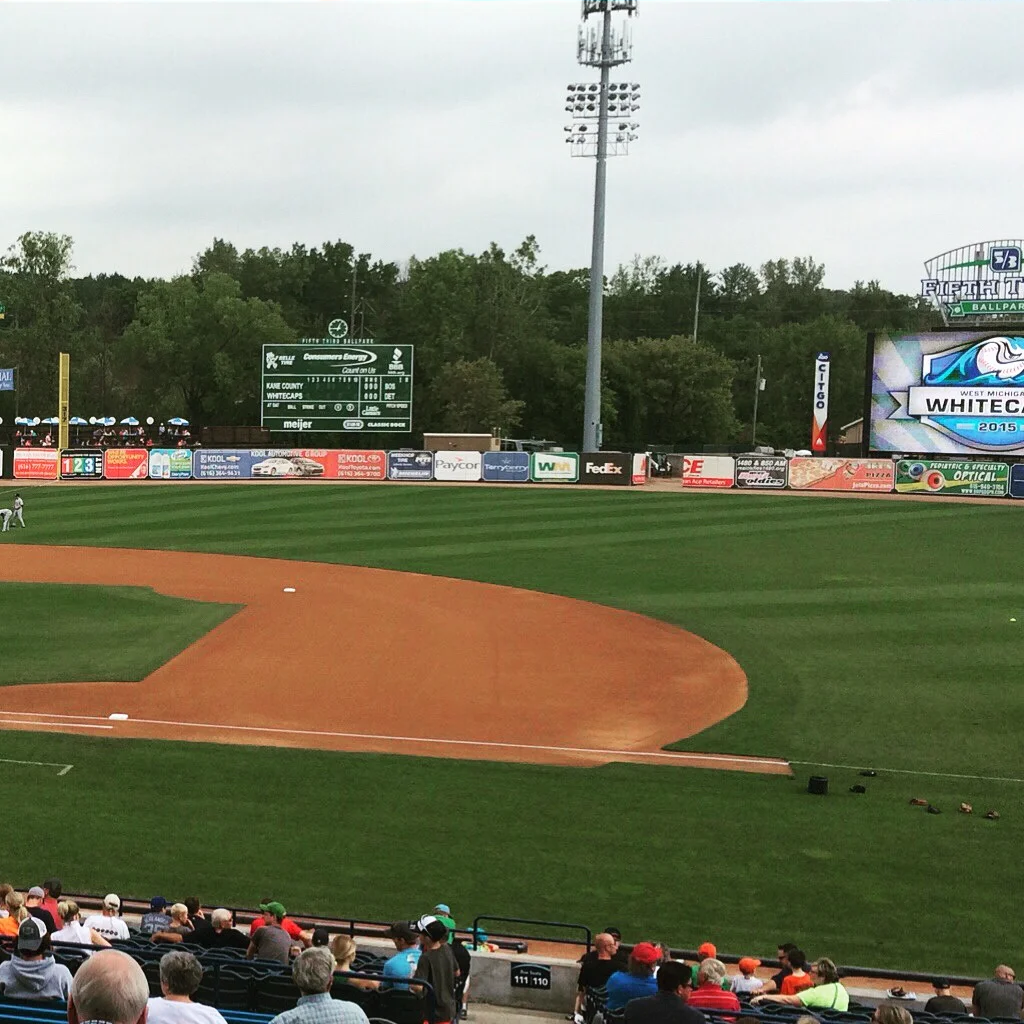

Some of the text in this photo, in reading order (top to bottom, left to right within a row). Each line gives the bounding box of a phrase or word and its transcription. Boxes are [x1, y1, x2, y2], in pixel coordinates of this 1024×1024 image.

[921, 278, 999, 296] FIFTH
[343, 353, 368, 361] Energy
[816, 364, 826, 409] CITGO
[266, 392, 303, 400] WHITECAPS
[926, 398, 1024, 414] WHITEC
[283, 419, 312, 431] meijer
[979, 422, 1016, 431] 2015
[207, 455, 226, 463] KOOL
[345, 454, 367, 462] KOOL
[63, 458, 94, 473] 123
[436, 459, 481, 471] Paycor
[485, 464, 528, 472] Terryberry
[538, 462, 571, 472] WM
[586, 462, 622, 474] FedEx
[953, 470, 997, 481] OPTICAL
[514, 976, 548, 986] 111 110
